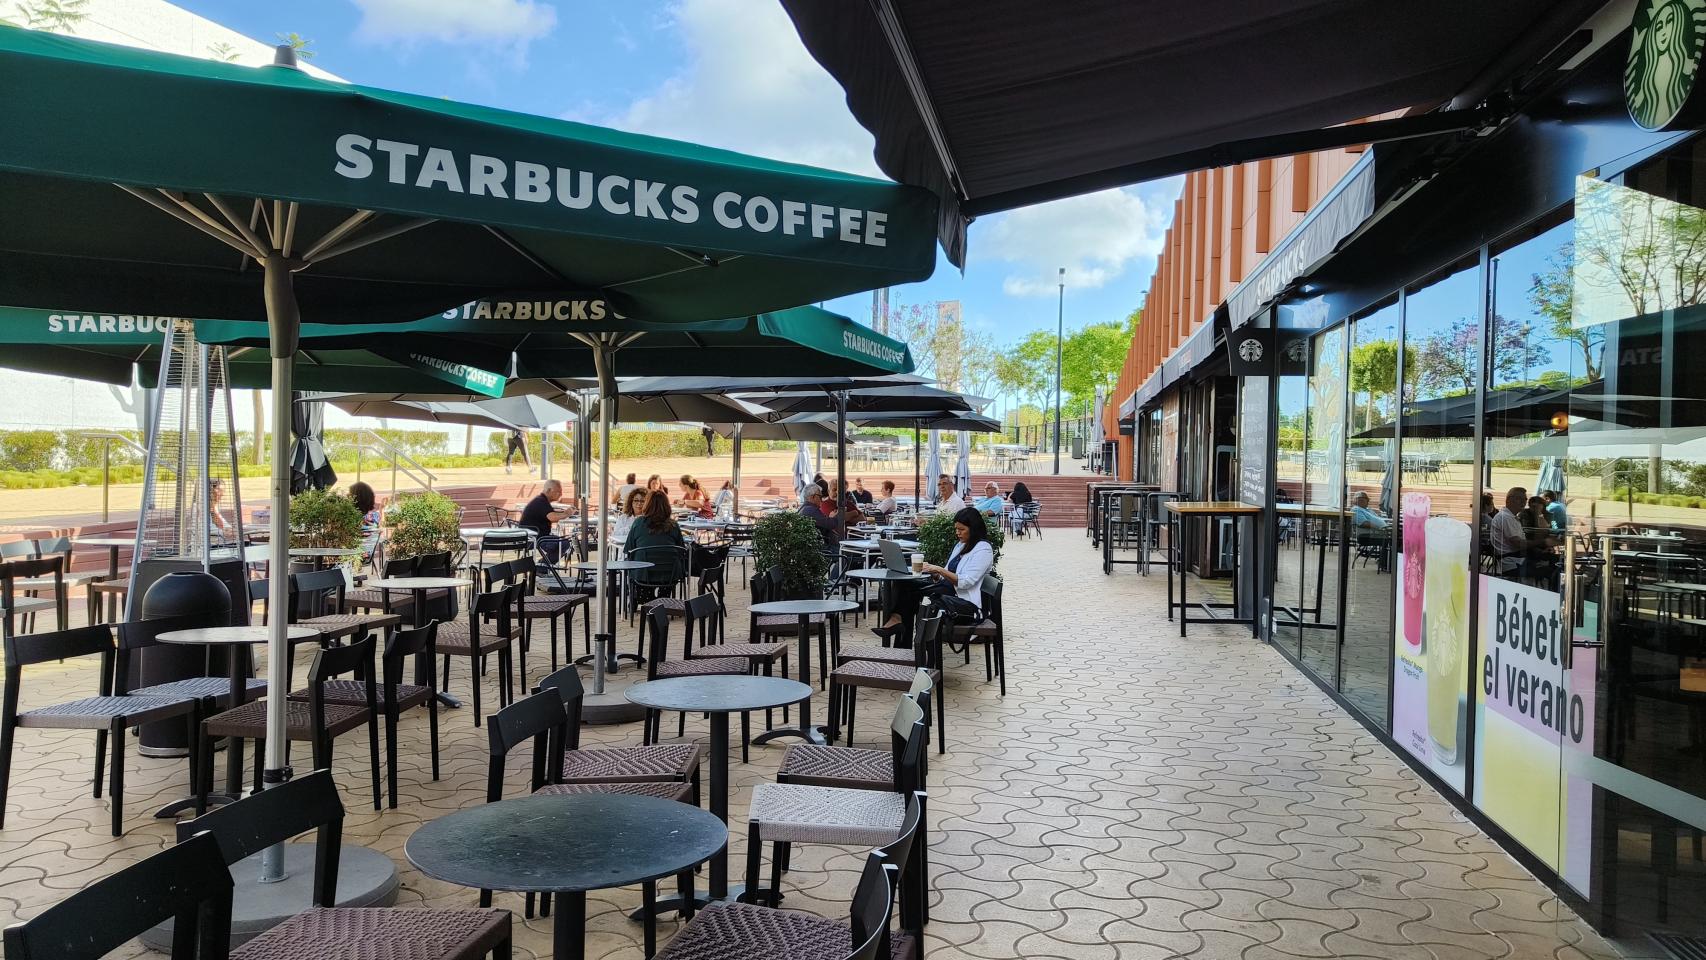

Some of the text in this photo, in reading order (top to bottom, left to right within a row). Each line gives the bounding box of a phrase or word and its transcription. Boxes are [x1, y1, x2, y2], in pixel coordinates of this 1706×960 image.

[334, 133, 888, 247] STARBUCKS COFFEE
[48, 315, 169, 333] STARBUC
[843, 330, 881, 359] STARBUCKS
[1495, 592, 1567, 667] Bébet
[1483, 647, 1584, 744] el verano
